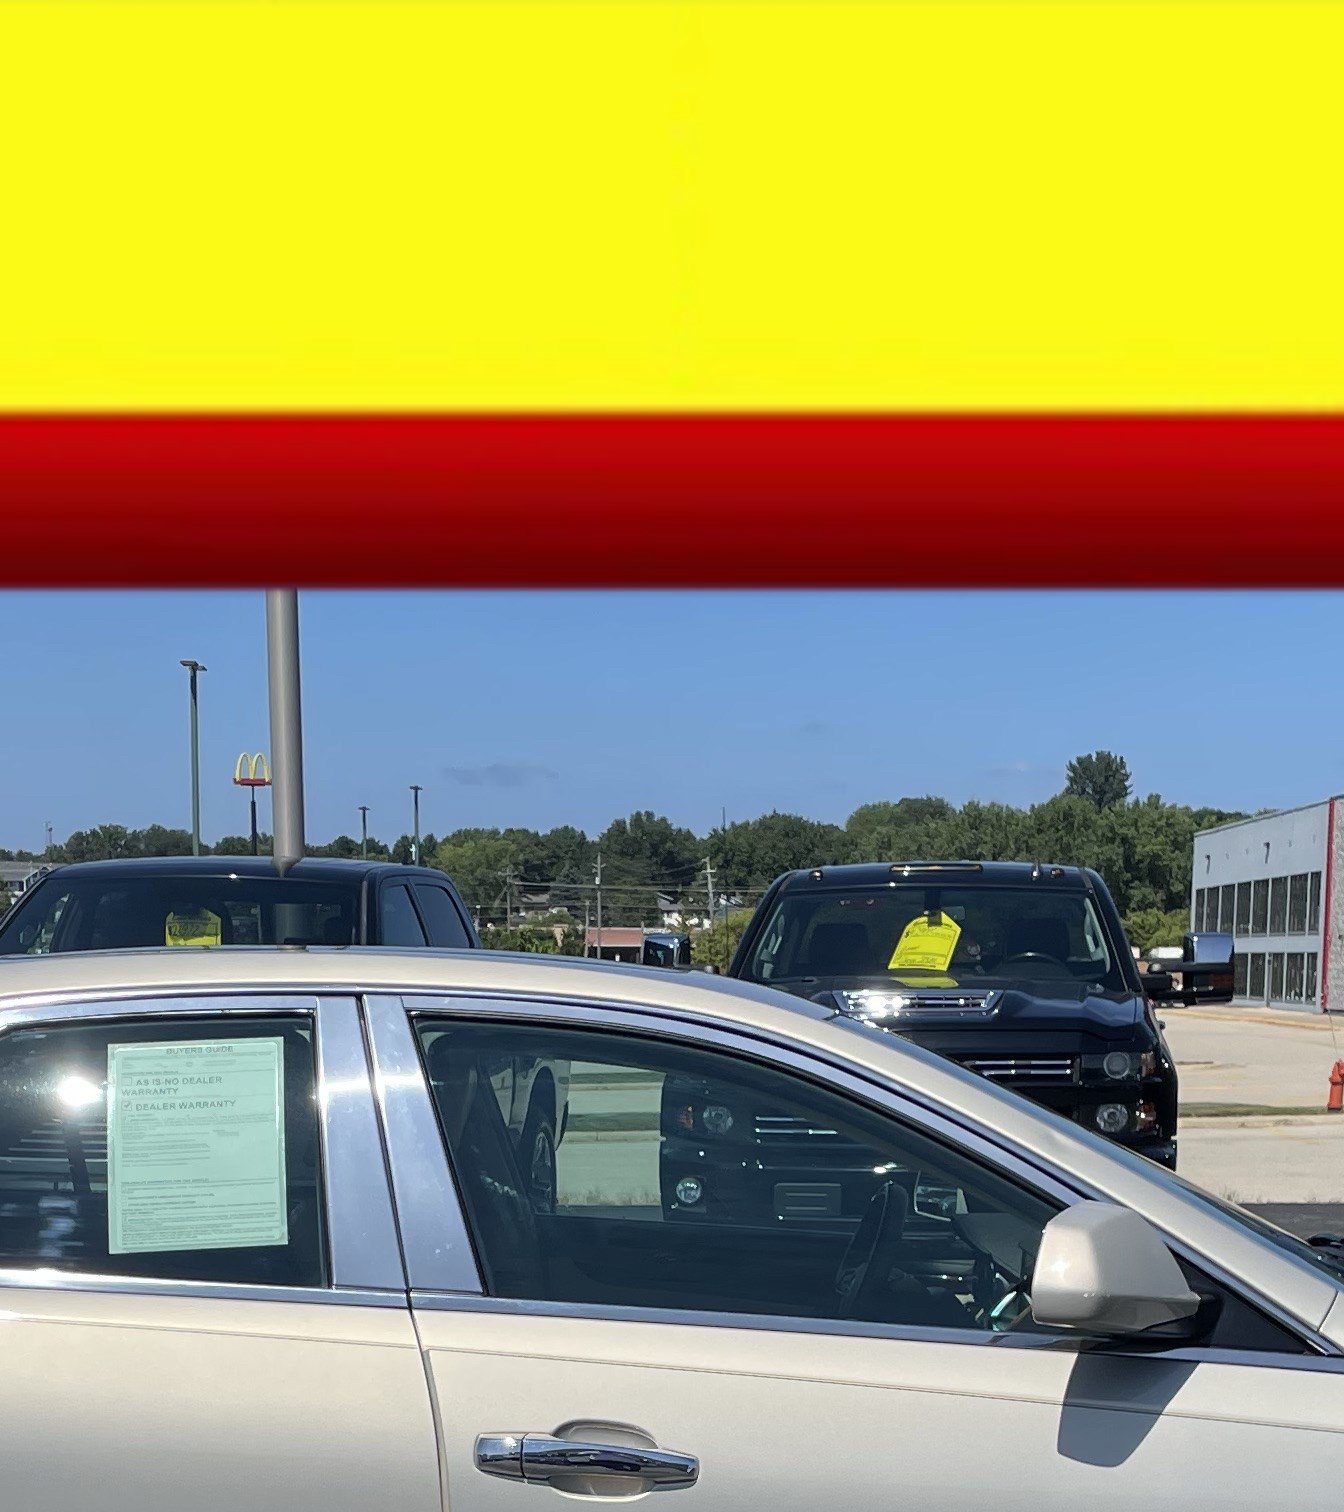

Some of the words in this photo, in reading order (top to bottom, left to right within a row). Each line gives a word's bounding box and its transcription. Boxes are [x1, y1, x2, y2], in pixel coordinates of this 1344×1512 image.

[165, 1046, 204, 1056] BUYERS
[206, 1045, 234, 1054] GUIDE
[136, 1078, 150, 1087] AS
[181, 1075, 223, 1085] DEALER
[121, 1087, 179, 1097] WARRANTY
[135, 1102, 177, 1112] DEALER
[178, 1099, 237, 1110] WARRANTY
